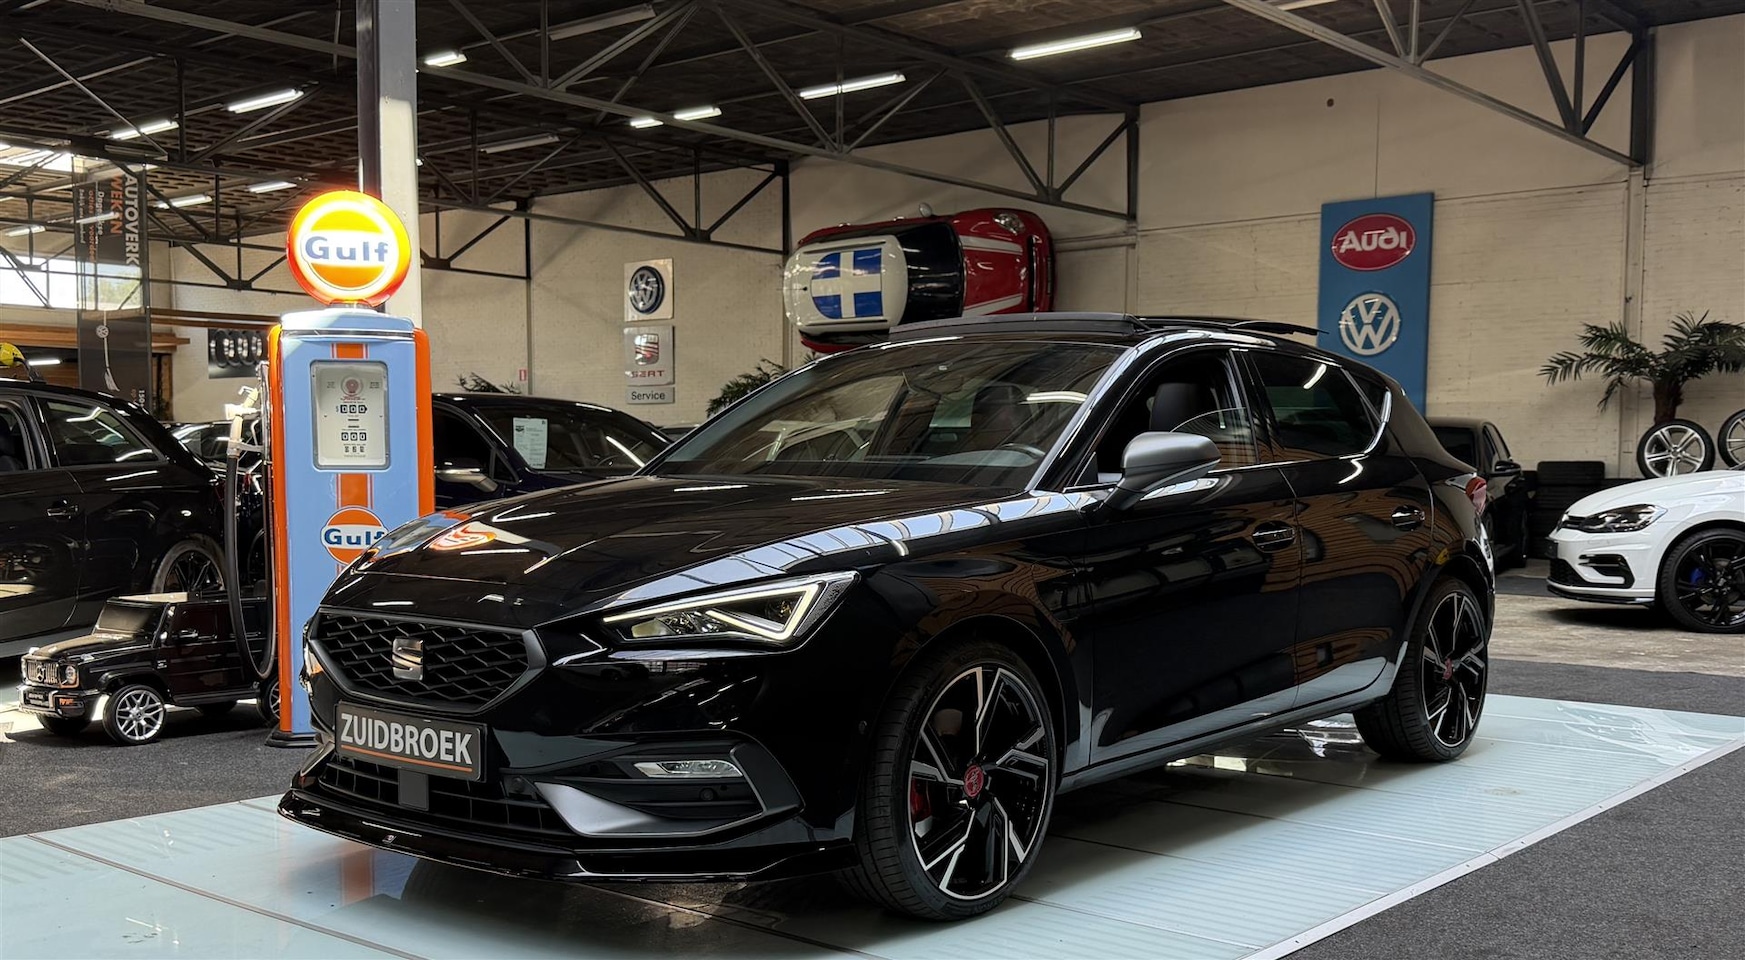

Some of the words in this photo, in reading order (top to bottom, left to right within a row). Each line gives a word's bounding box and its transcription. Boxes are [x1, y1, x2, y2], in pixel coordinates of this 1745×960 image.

[125, 174, 140, 265] AUTOVERK
[304, 235, 389, 262] Gulf
[631, 390, 666, 401] Service
[340, 713, 473, 765] ZUIDBROEK
